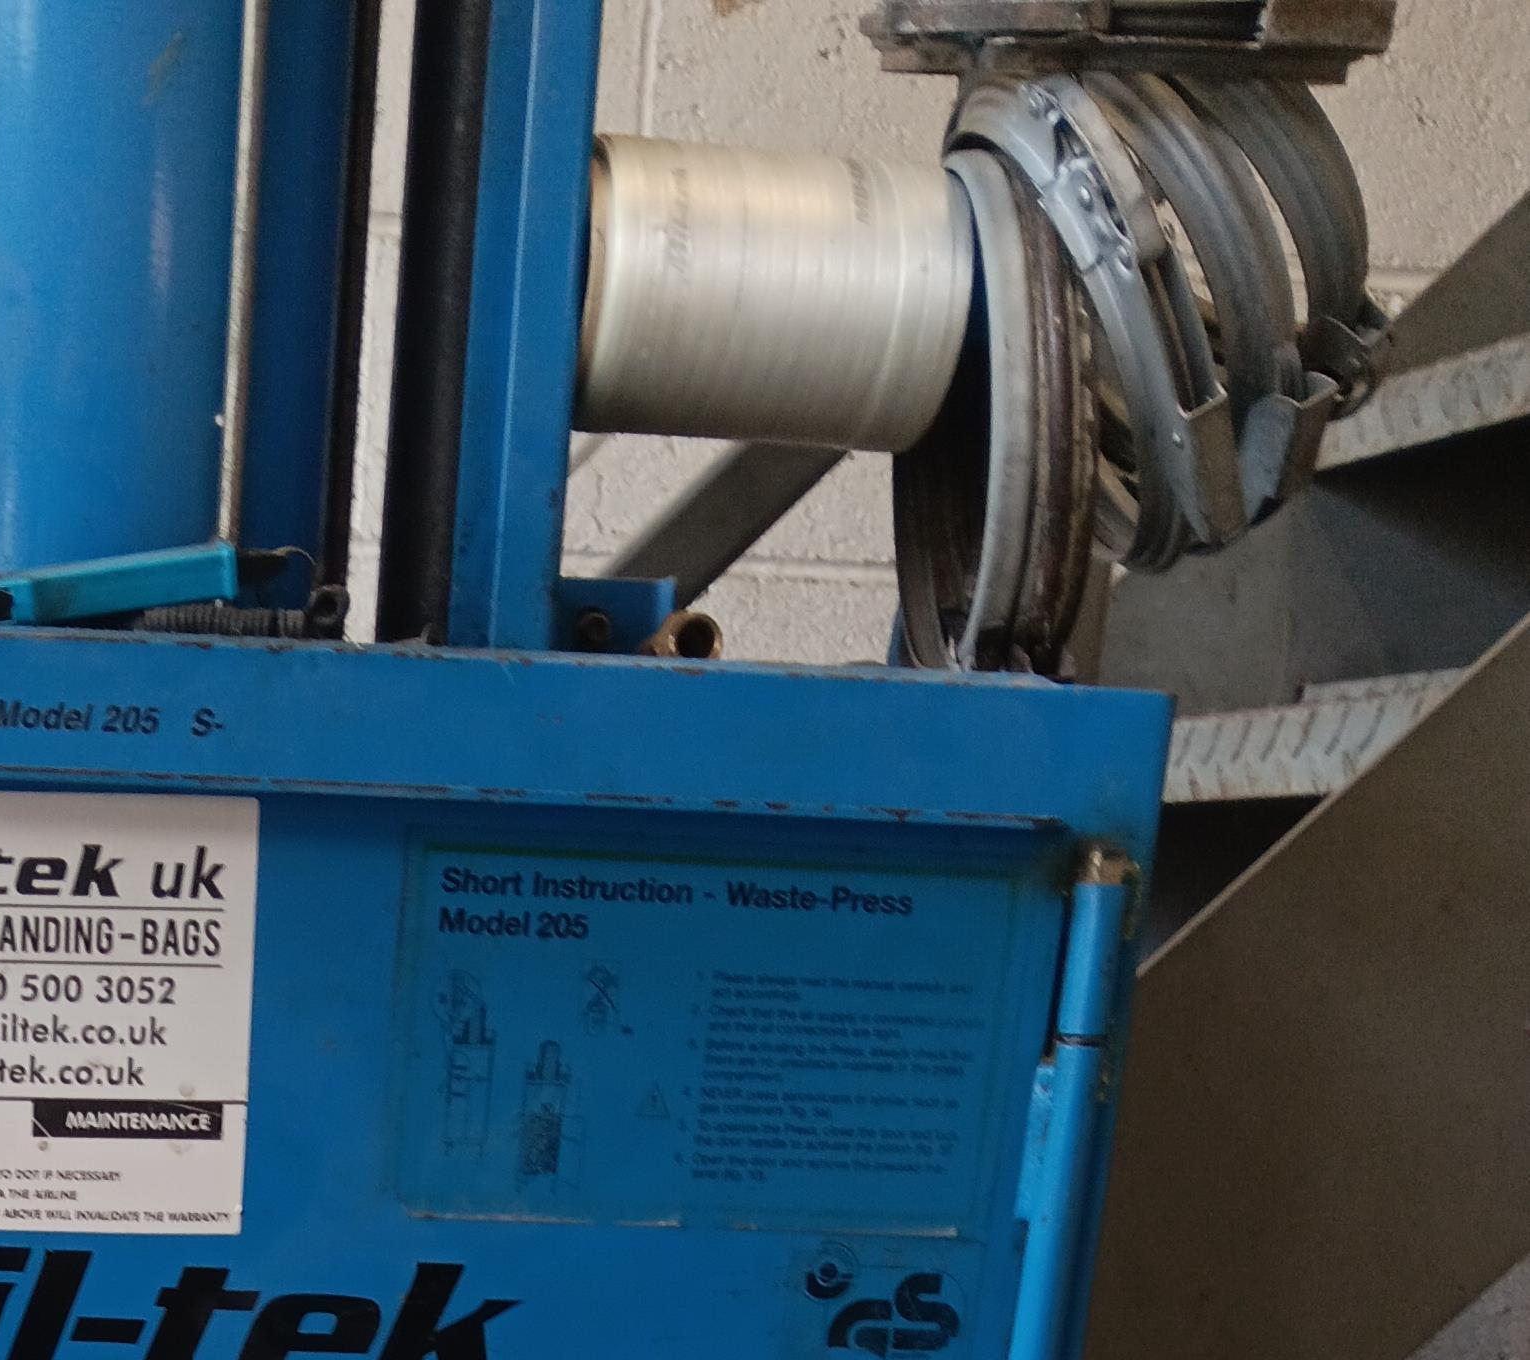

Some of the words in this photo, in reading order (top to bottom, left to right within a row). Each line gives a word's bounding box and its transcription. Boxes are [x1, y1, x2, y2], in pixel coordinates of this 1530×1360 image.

[101, 703, 162, 735] 205
[151, 845, 225, 901] uk
[441, 866, 523, 897] Short
[533, 871, 694, 905] Instruction
[726, 879, 914, 917] Waste-Press
[439, 908, 530, 937] Model
[536, 912, 590, 941] 205
[20, 973, 83, 1003] 500
[95, 974, 176, 1005] 3052
[64, 1111, 212, 1132] MAINTENANCE
